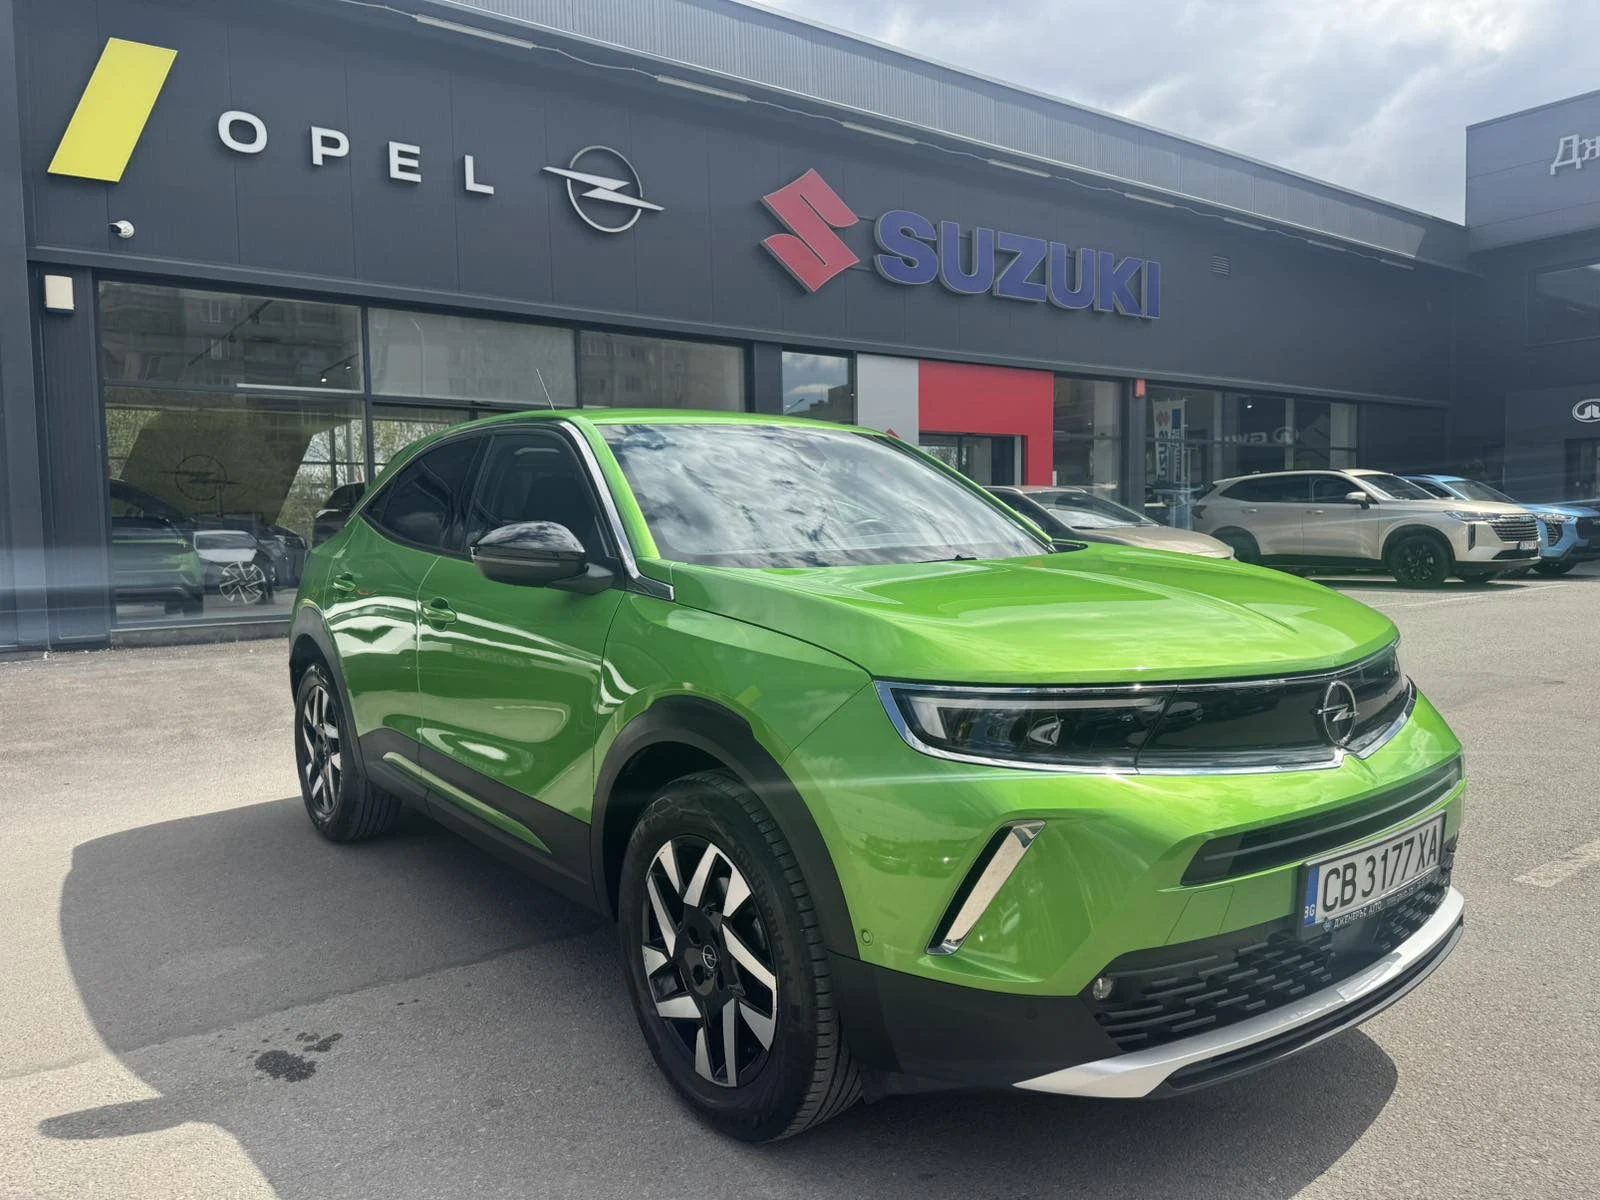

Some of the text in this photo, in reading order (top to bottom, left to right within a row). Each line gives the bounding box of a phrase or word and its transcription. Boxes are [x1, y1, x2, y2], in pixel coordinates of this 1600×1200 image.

[218, 110, 494, 195] OPEL
[873, 209, 1160, 319] SUZUKI
[1322, 862, 1357, 912] CB
[1361, 836, 1415, 897] 3177
[1416, 825, 1437, 873] XA
